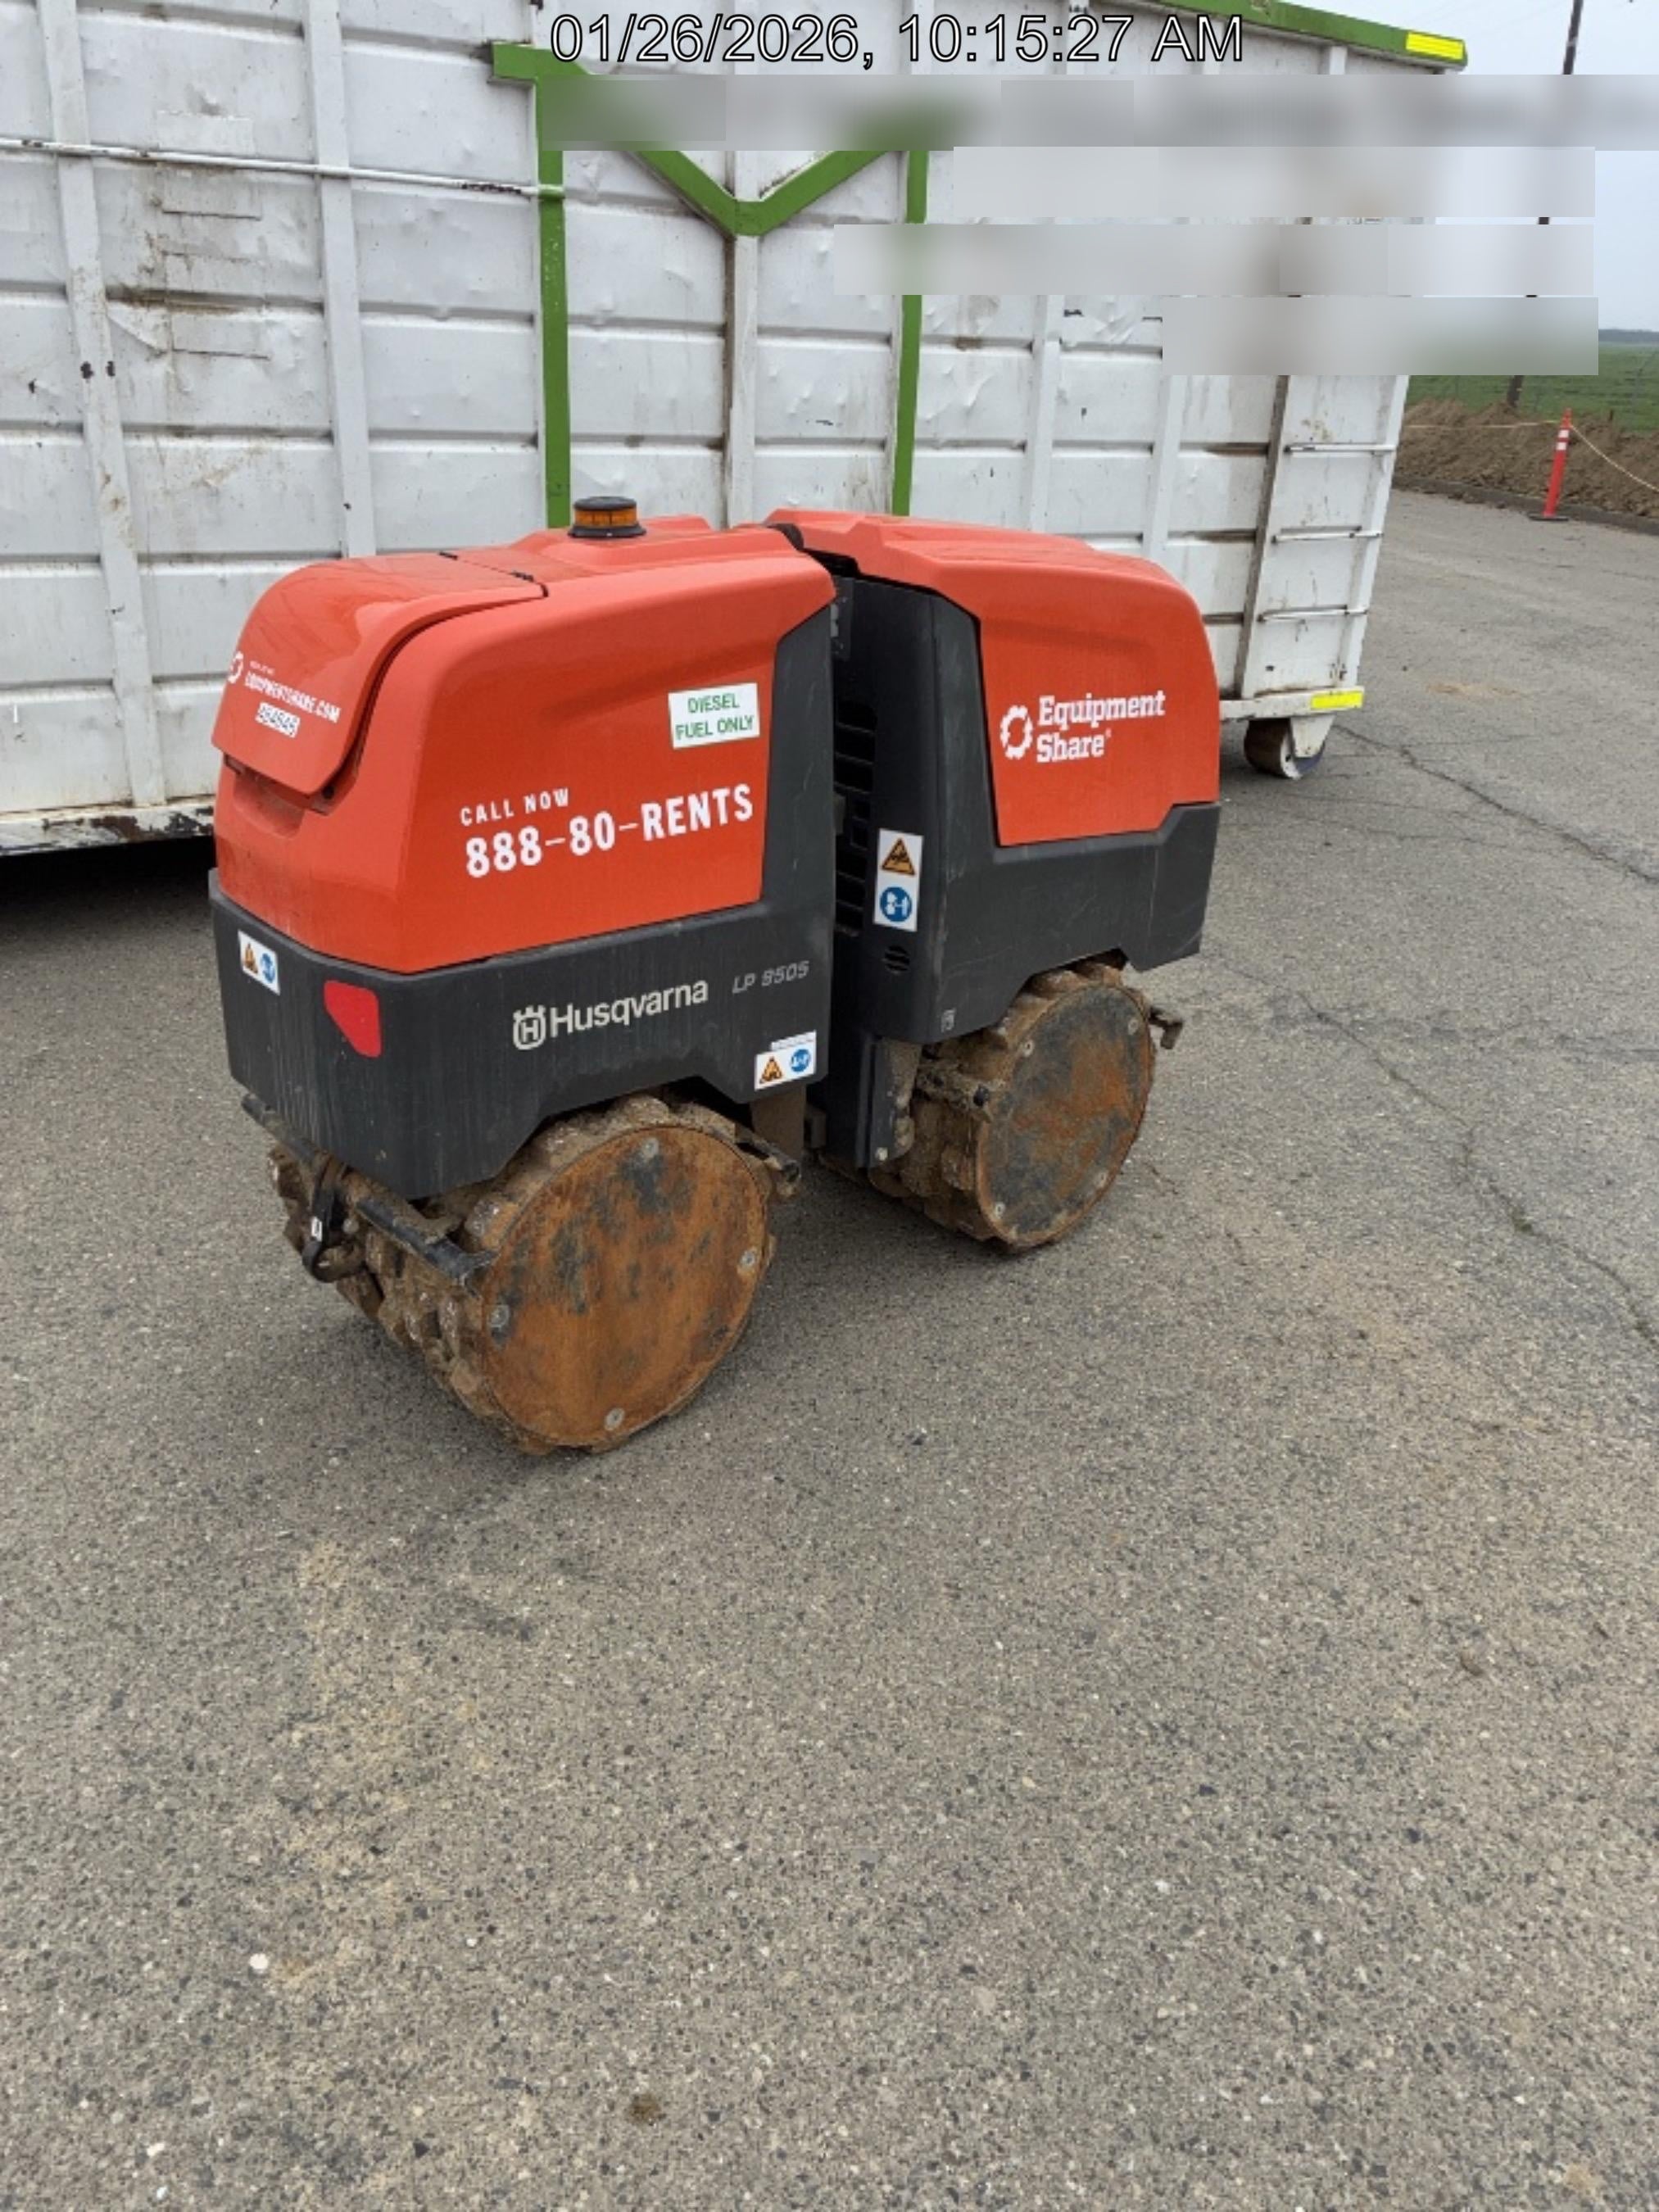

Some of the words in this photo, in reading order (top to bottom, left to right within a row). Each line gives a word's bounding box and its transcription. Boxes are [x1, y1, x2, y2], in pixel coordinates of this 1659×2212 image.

[687, 692, 740, 714] DIESEL
[1038, 690, 1166, 731] Equipment
[675, 722, 713, 741] FUEL
[717, 715, 754, 735] ONLY
[460, 800, 514, 827] CALL
[524, 787, 569, 814] NOW
[465, 783, 754, 879] 888-80-RENTS
[732, 972, 756, 995] LP
[550, 980, 709, 1038] Husqvarna
